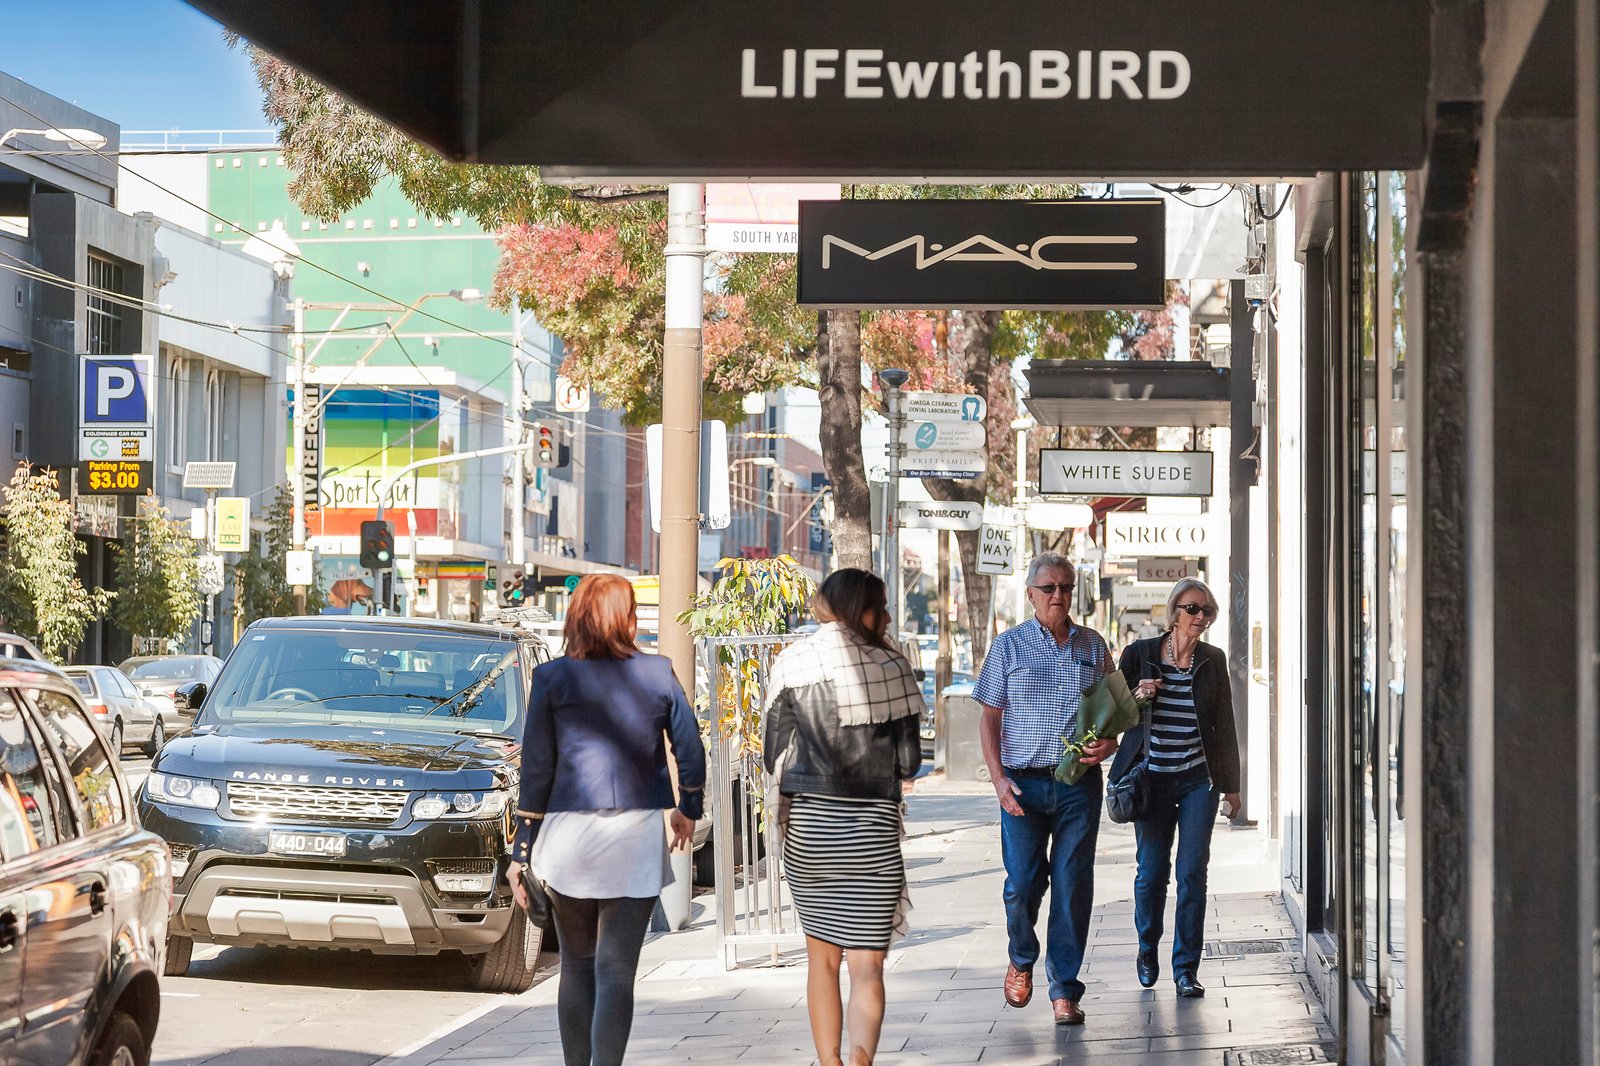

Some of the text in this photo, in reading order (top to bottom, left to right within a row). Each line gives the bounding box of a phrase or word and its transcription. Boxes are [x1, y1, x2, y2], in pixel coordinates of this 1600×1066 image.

[740, 48, 1192, 101] LIFEwithBIRD
[733, 230, 771, 243] SOUTH
[96, 366, 135, 416] P
[89, 461, 140, 472] Parking From
[1062, 465, 1192, 480] WHITE SUEDE
[89, 471, 139, 490] $3.00
[917, 509, 971, 519] TONI&GUY
[986, 528, 1011, 541] ONE
[1114, 526, 1206, 544] SIRICCO
[983, 543, 1012, 557] WAY
[1146, 563, 1188, 578] seed
[232, 770, 405, 787] RANGE ROVER
